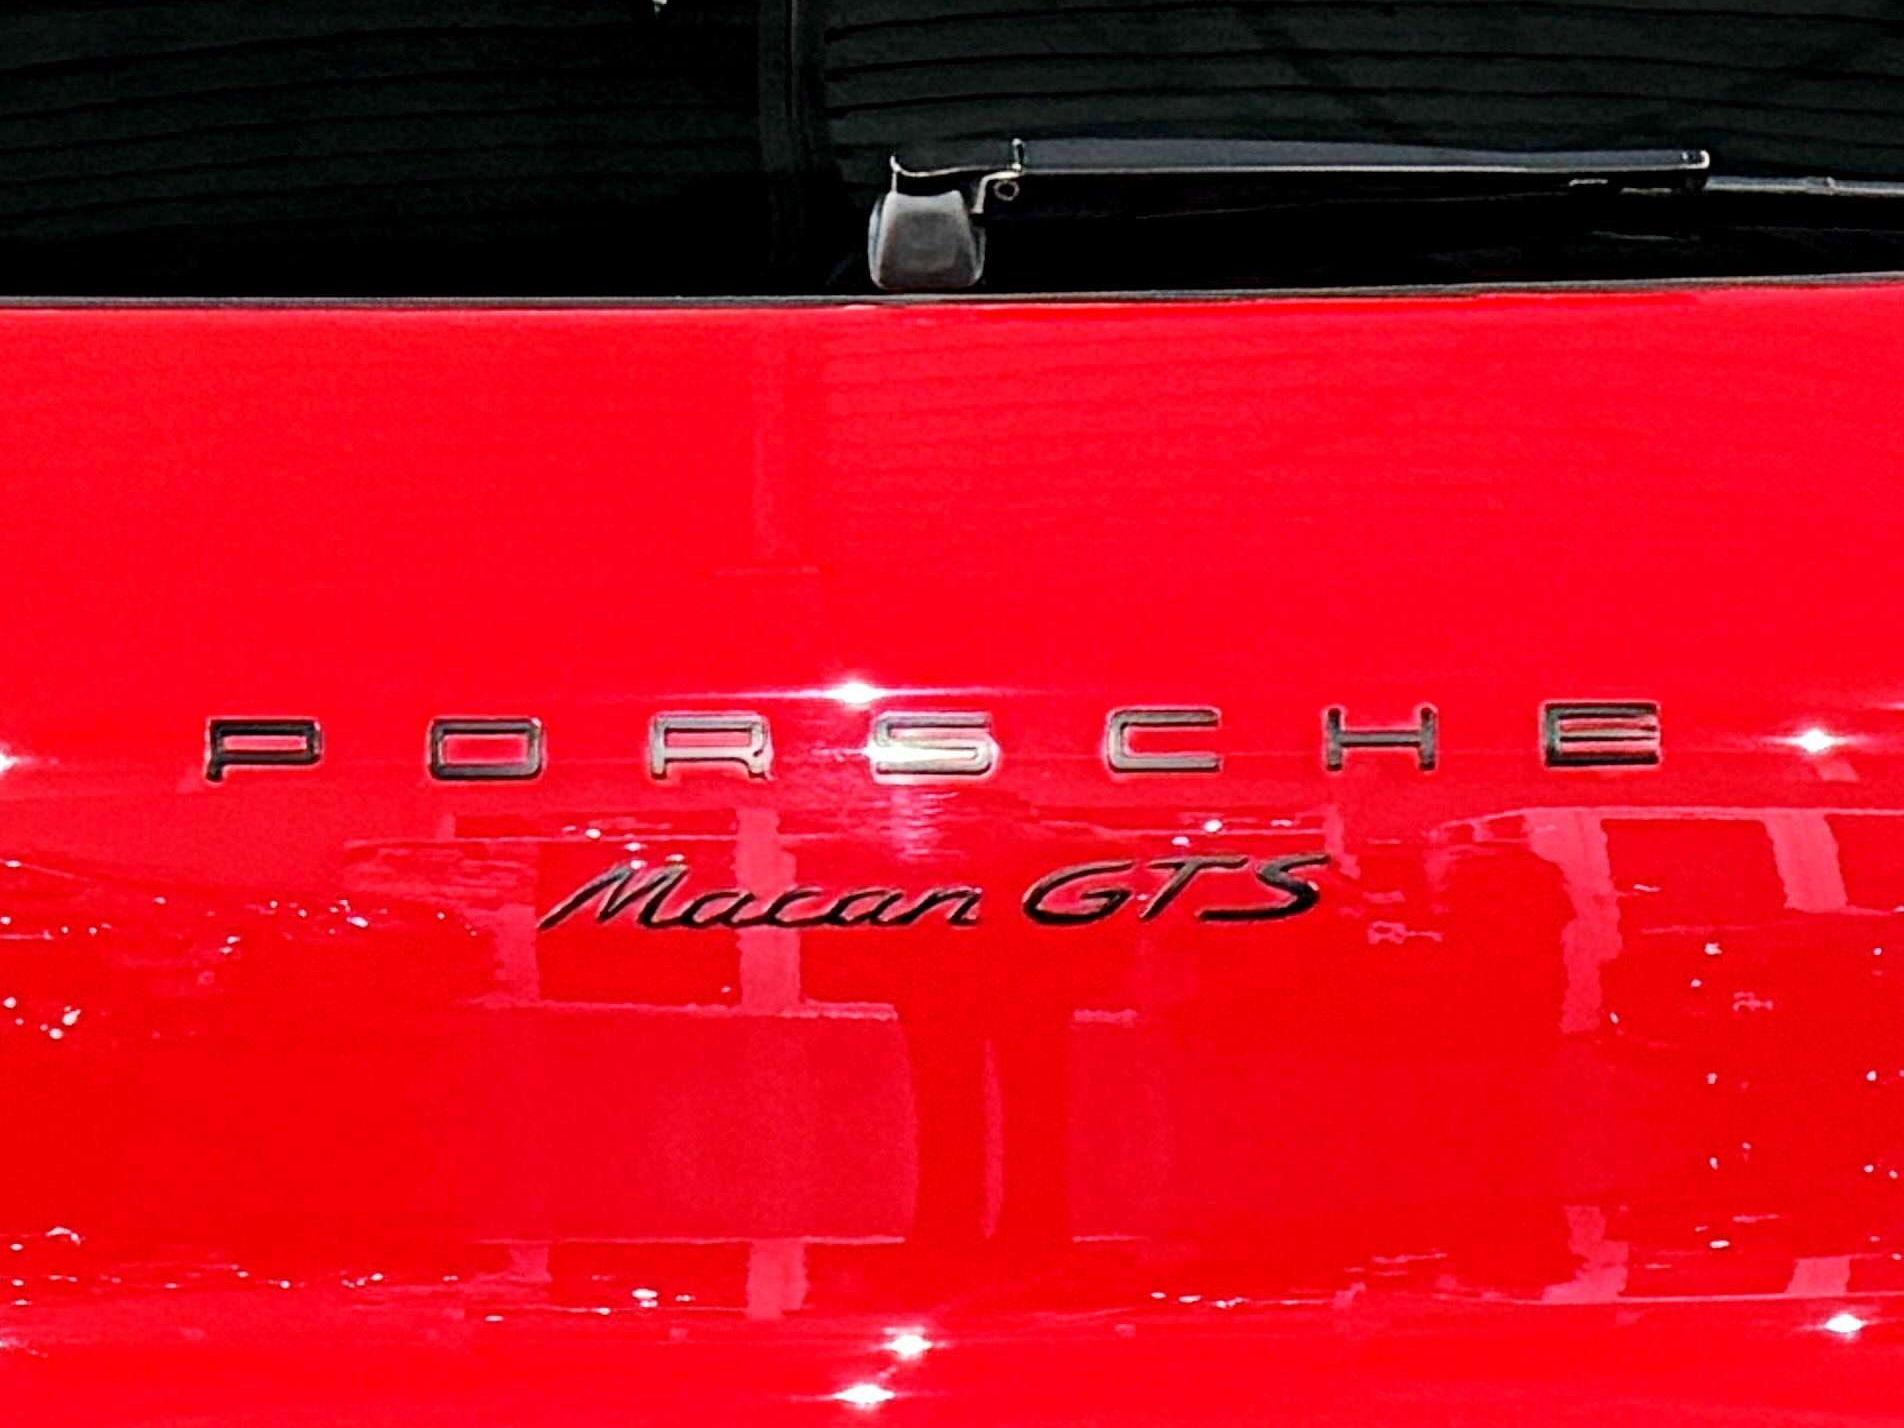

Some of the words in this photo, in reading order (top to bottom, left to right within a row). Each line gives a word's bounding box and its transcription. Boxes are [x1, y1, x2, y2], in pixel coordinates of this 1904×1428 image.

[204, 700, 1662, 783] PORSCHE
[537, 860, 983, 931] Macan
[1021, 853, 1332, 927] GTS
